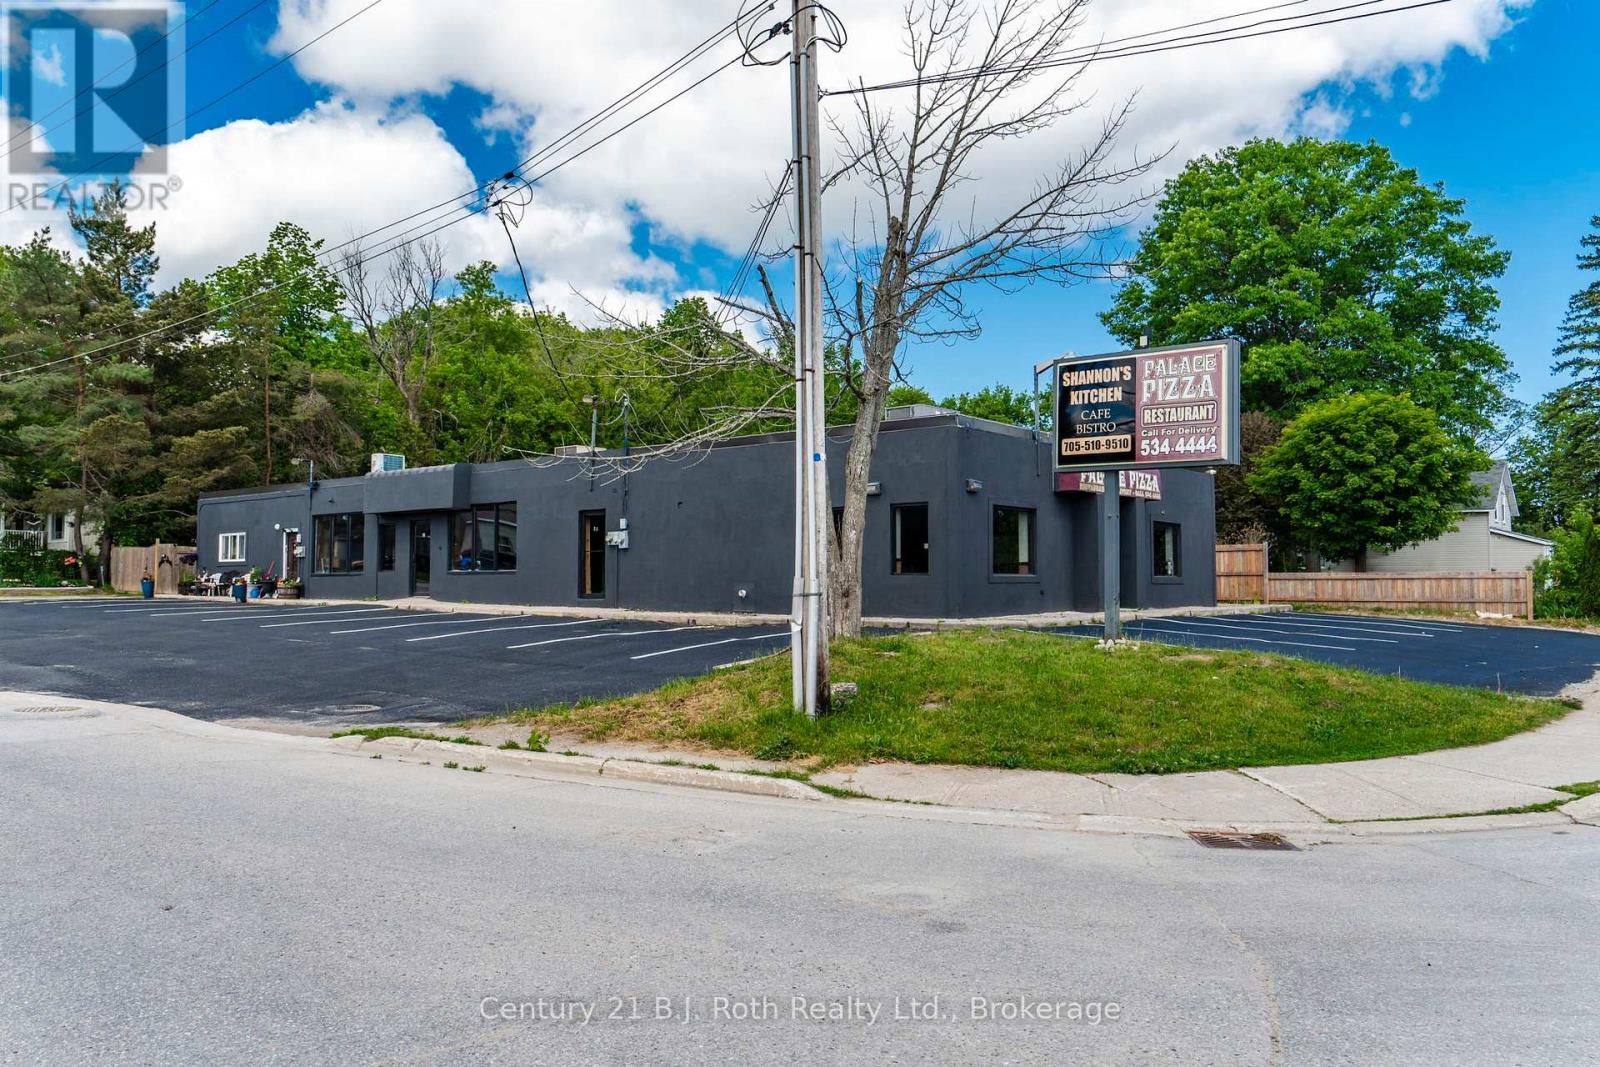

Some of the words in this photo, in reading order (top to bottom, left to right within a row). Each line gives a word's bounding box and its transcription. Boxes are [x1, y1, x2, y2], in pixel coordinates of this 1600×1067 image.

[1144, 353, 1217, 378] PALACE
[1062, 365, 1132, 387] SHANNON'S
[1070, 386, 1122, 405] KITCHEN
[1141, 374, 1217, 404] PIZZA
[1081, 408, 1111, 421] CAFE
[1143, 404, 1215, 424] RESTAURANT
[1076, 421, 1116, 435] BISTRO
[1141, 428, 1159, 437] Call
[1161, 427, 1176, 436] For
[1178, 425, 1217, 436] Delivery
[1063, 437, 1129, 452] 705-510-9510
[1129, 471, 1160, 492] PIZZA
